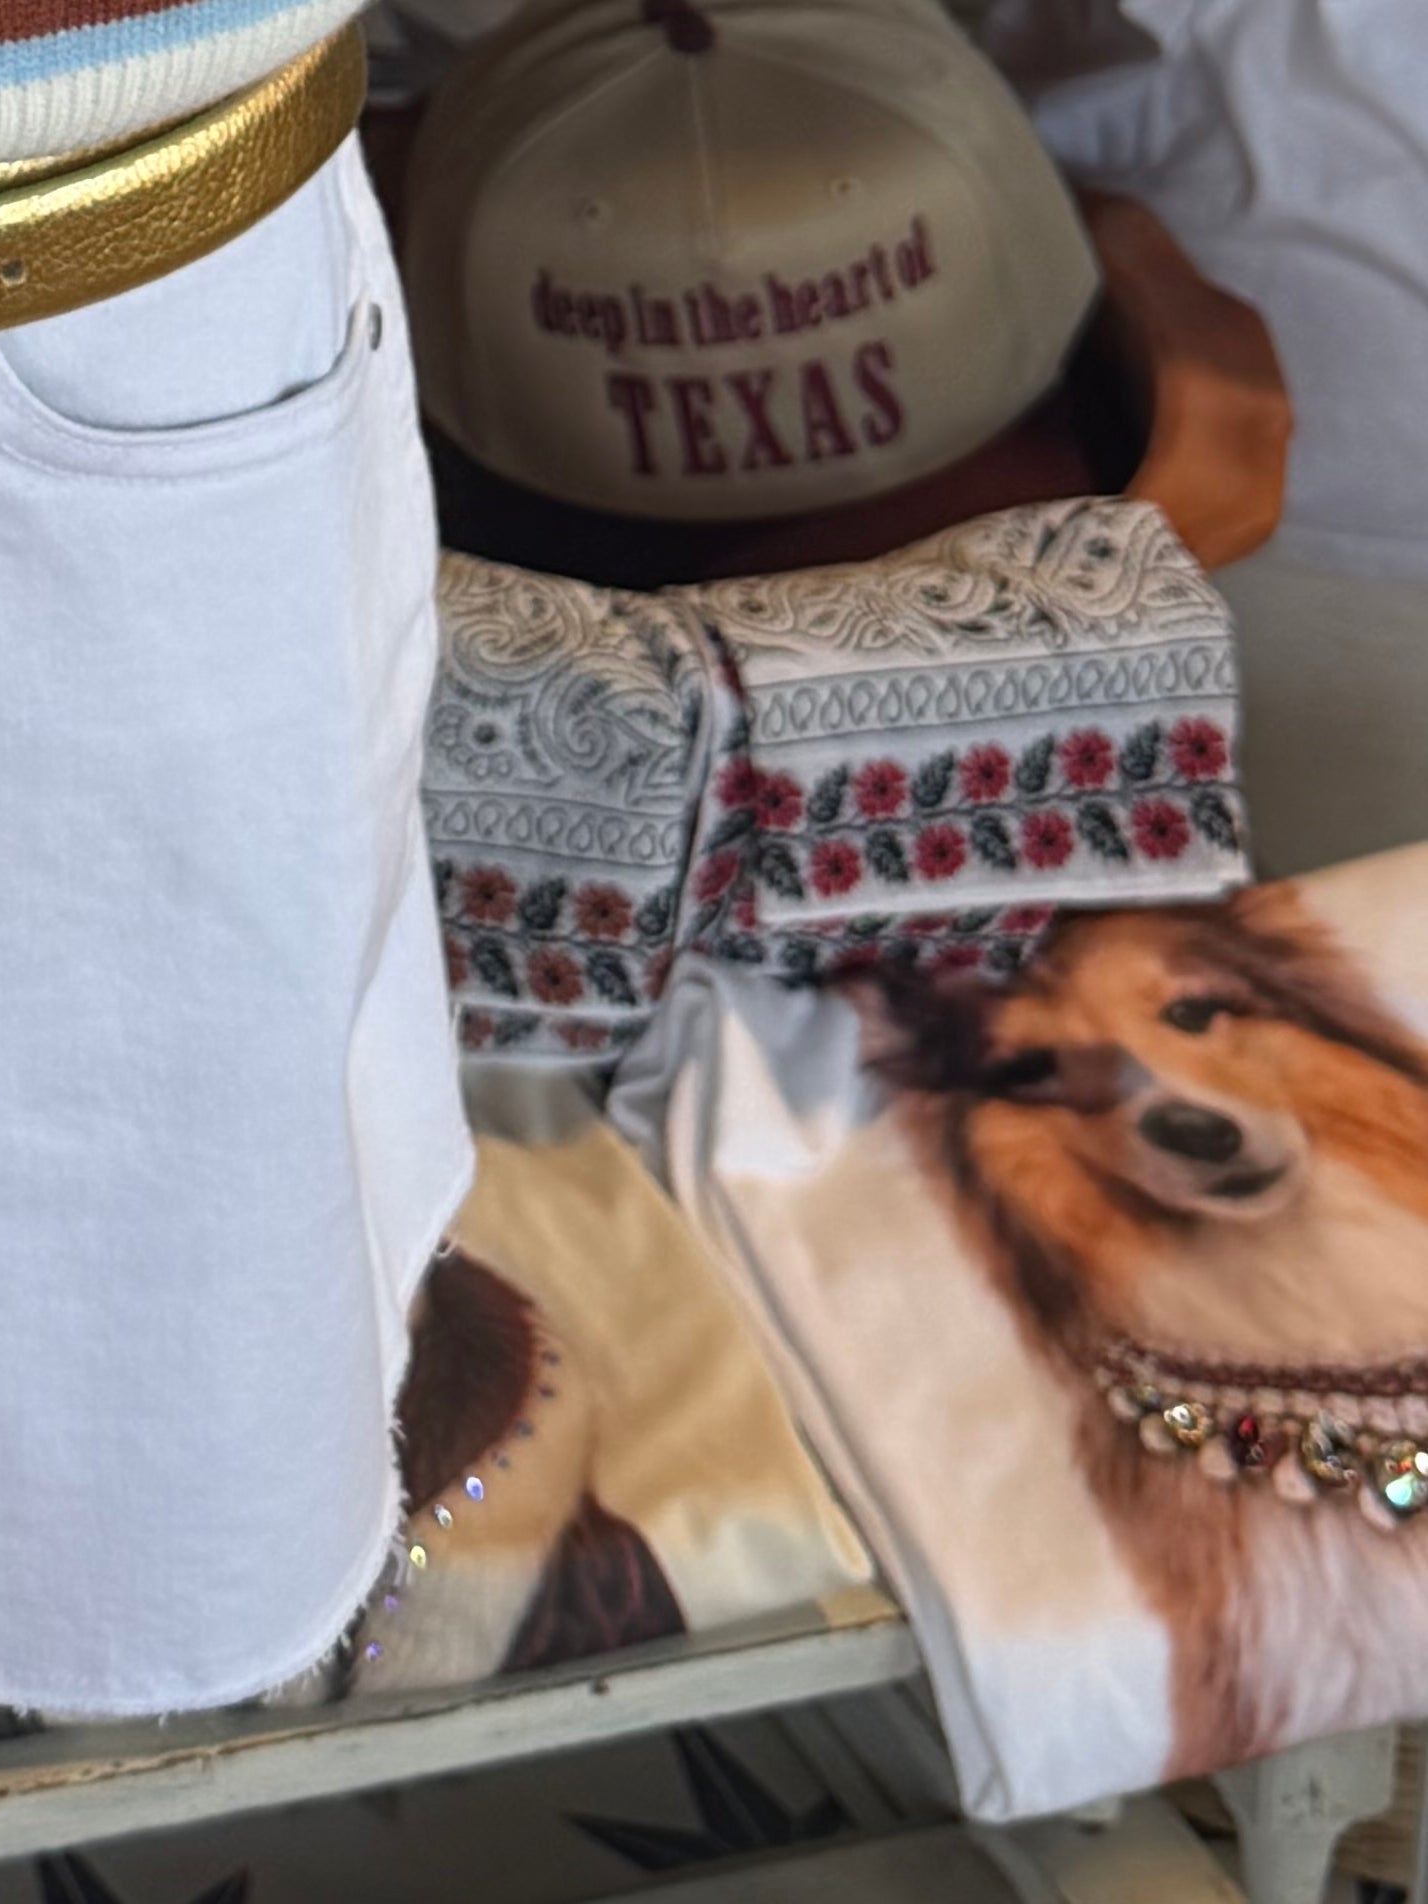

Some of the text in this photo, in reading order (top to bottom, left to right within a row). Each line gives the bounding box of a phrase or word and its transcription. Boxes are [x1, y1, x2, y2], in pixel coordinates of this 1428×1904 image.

[531, 212, 937, 355] deep in the heart of
[605, 340, 907, 477] TEXAS
